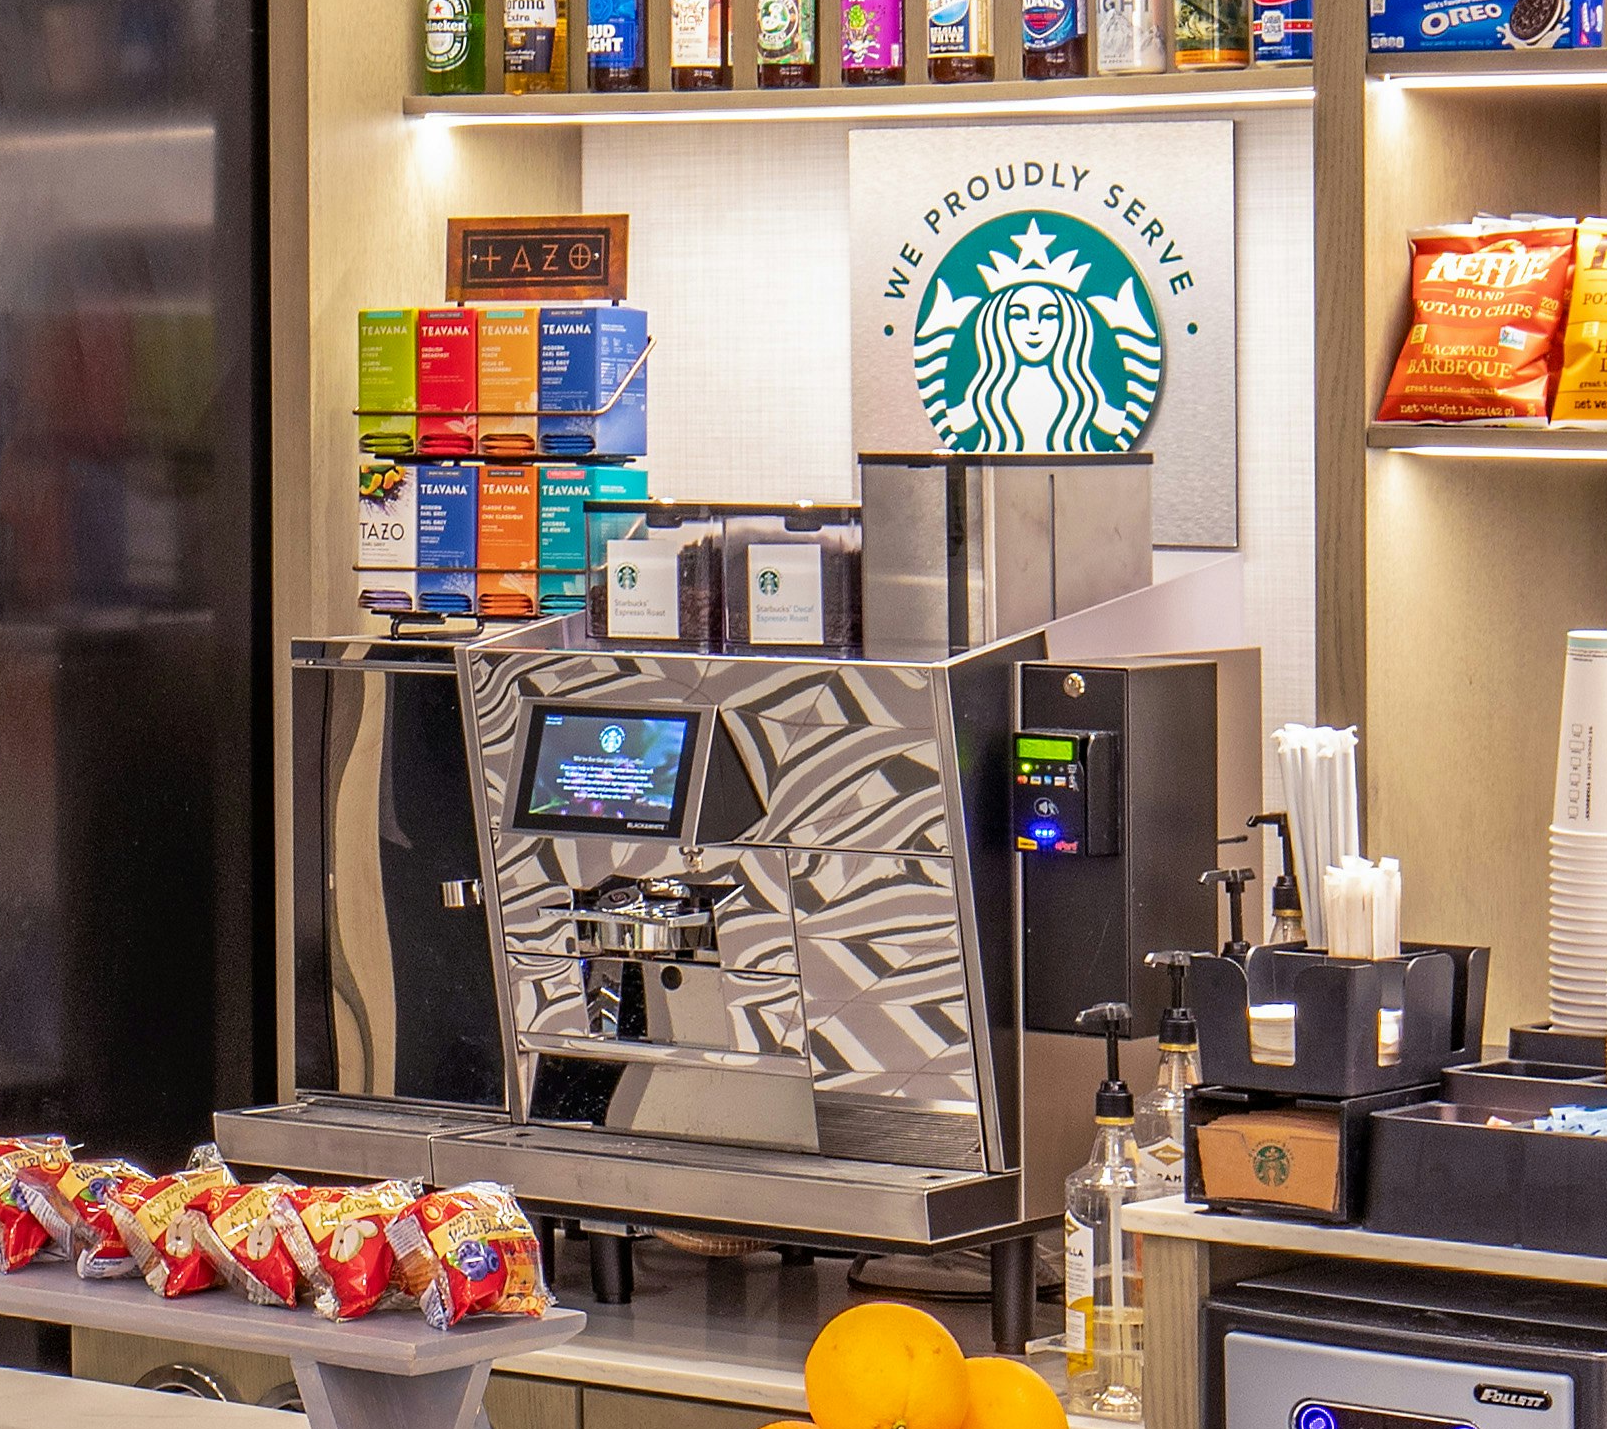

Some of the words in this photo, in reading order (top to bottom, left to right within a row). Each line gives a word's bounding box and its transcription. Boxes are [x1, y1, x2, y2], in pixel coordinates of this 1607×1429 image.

[1418, 2, 1503, 37] OREO
[883, 241, 927, 303] WE
[922, 160, 1091, 235] PROUDLY
[1103, 182, 1196, 297] SERVE
[1455, 287, 1506, 302] BRAND
[1416, 298, 1483, 318] POTATO
[1485, 302, 1534, 319] CHIPS
[421, 325, 470, 338] TEAVANA
[481, 325, 531, 337] TEAVANA
[542, 323, 592, 336] TEAVANA
[1421, 341, 1499, 358] BACKYARD
[1406, 358, 1514, 382] BARBEQUE
[1574, 399, 1592, 410] net
[359, 522, 405, 542] TAZO
[1479, 1387, 1546, 1409] FOLLETT
